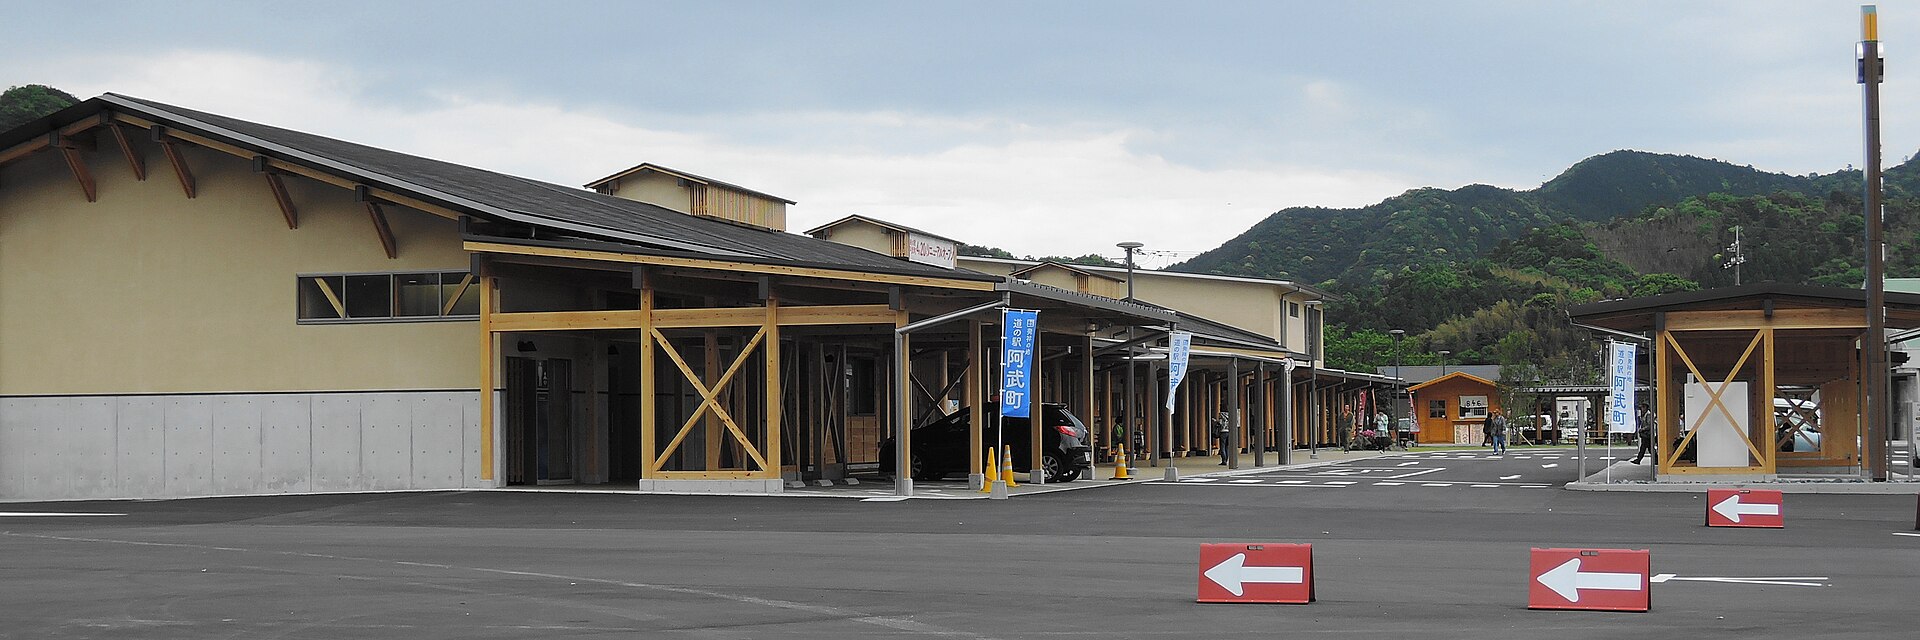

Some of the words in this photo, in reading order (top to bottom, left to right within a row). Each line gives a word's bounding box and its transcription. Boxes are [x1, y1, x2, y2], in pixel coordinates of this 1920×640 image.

[1012, 318, 1023, 347] 道の駅
[1005, 349, 1025, 410] 阿武町
[1612, 375, 1627, 426] 阿武町
